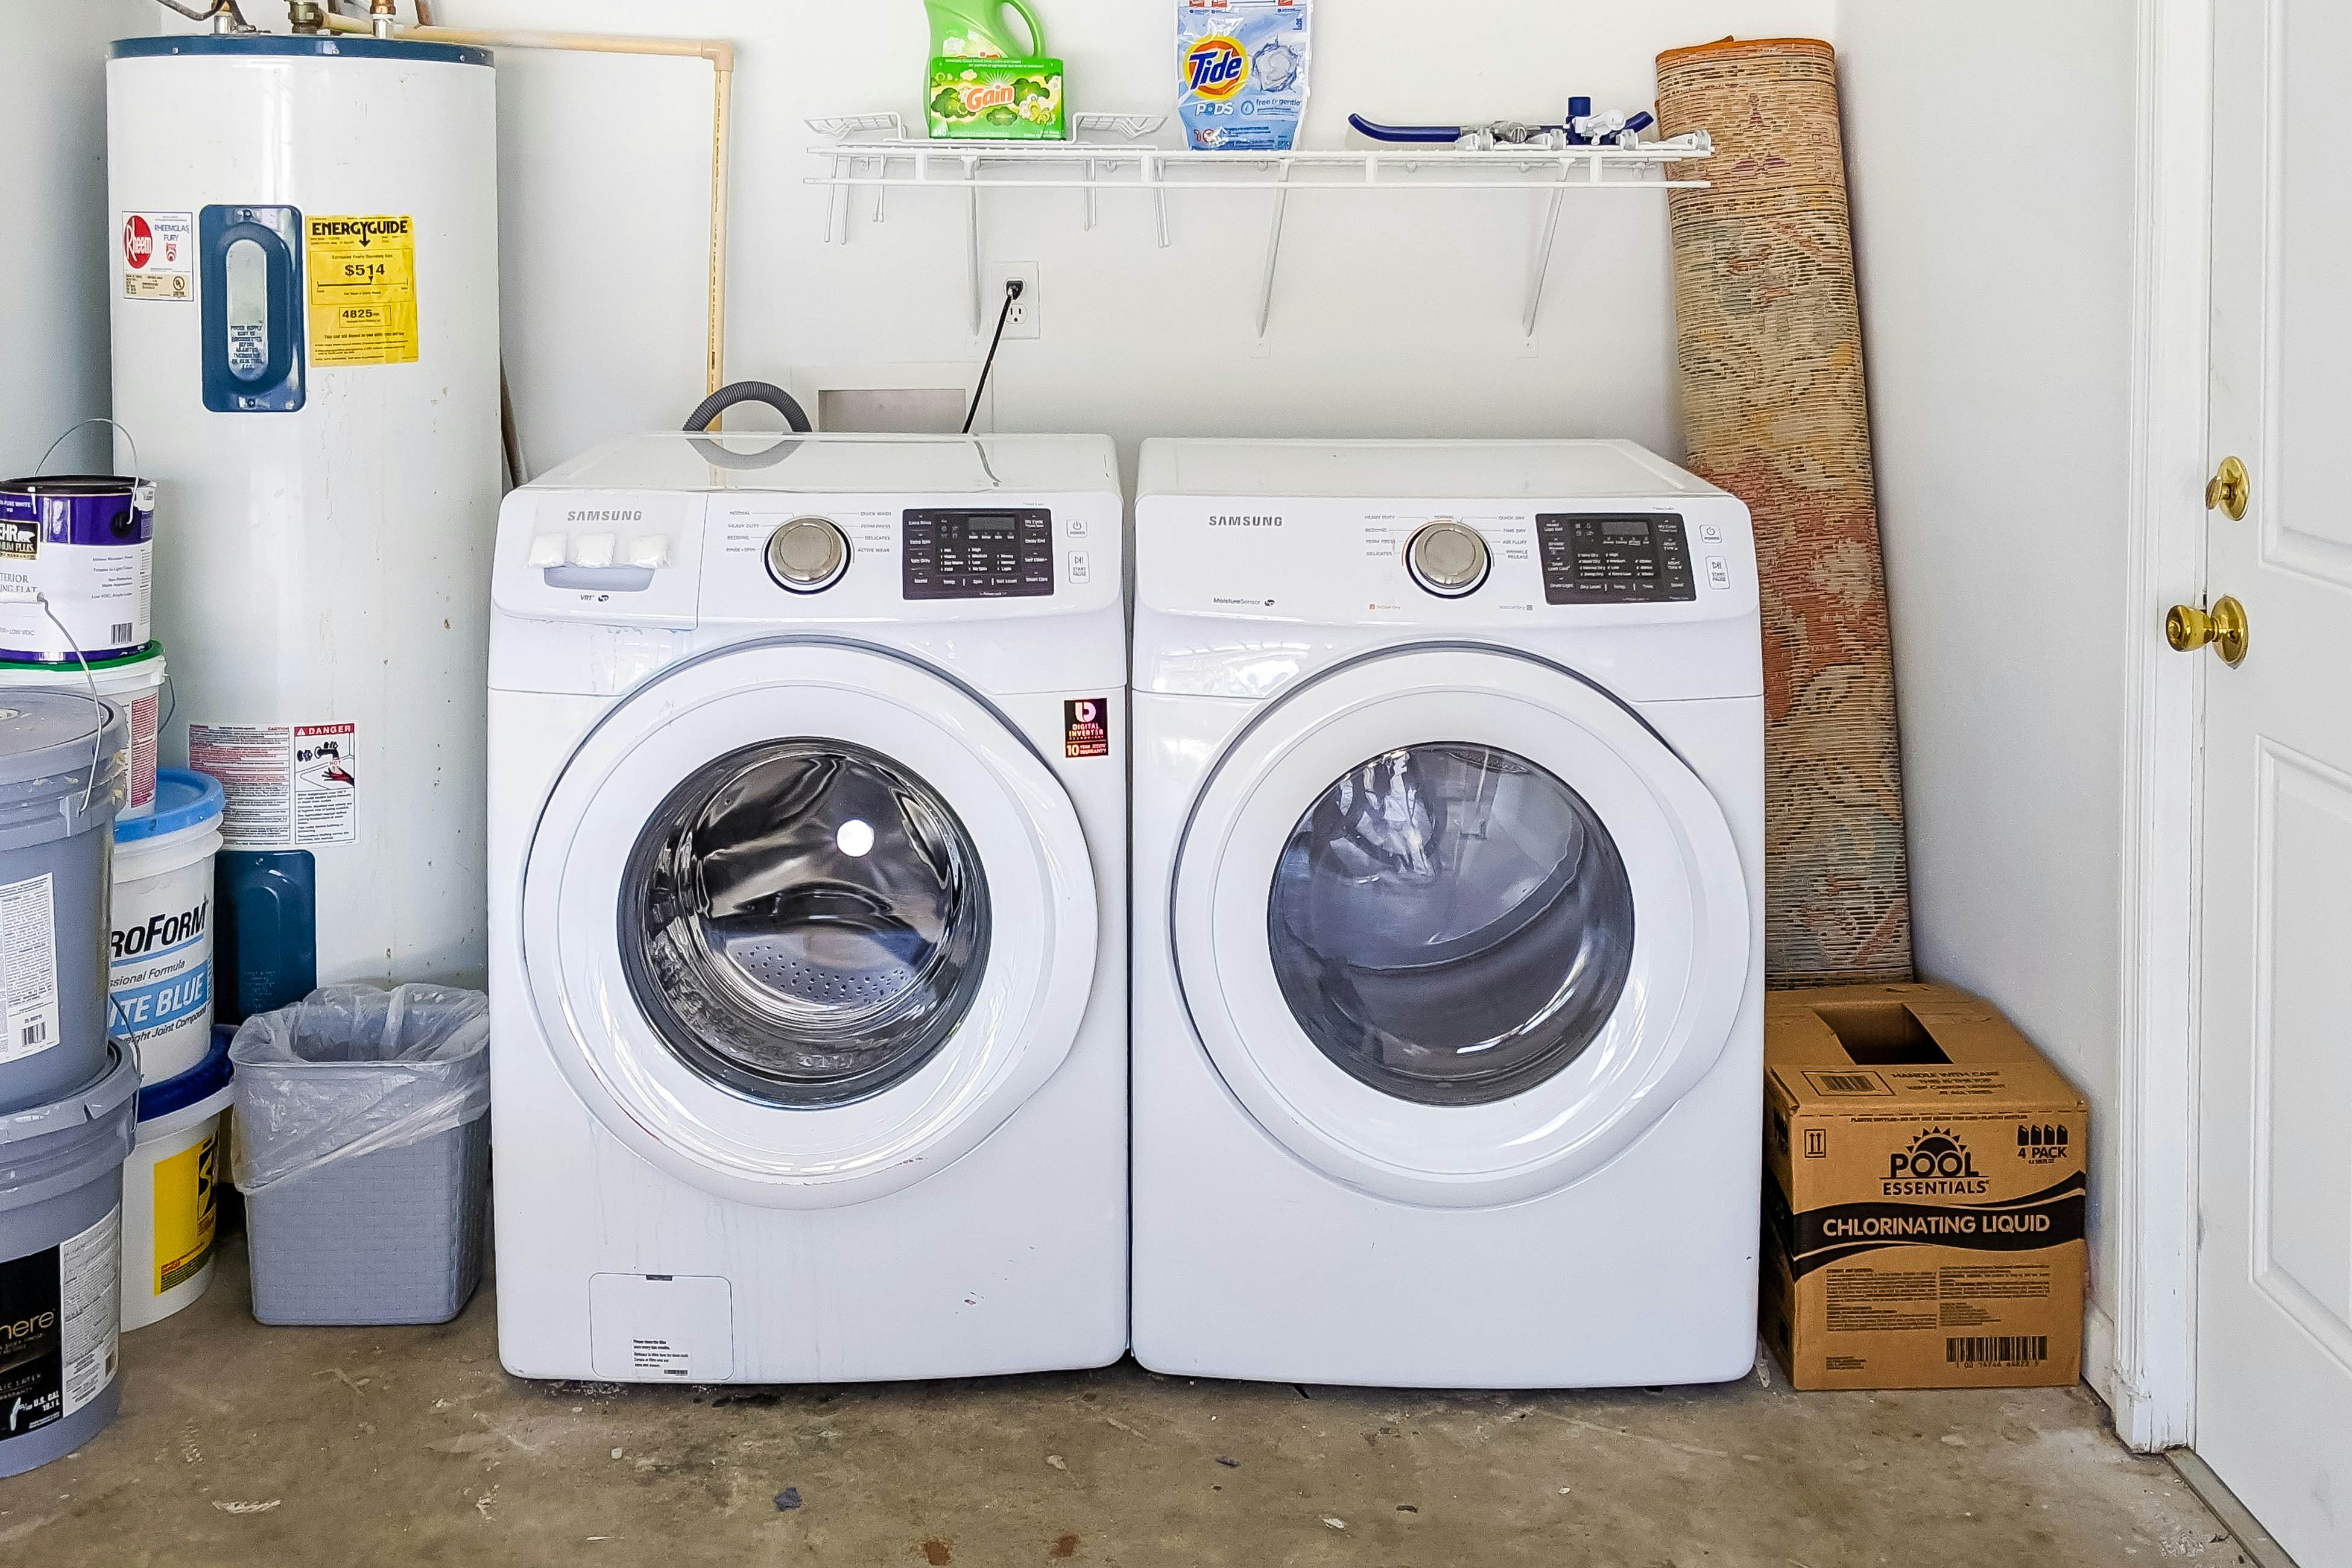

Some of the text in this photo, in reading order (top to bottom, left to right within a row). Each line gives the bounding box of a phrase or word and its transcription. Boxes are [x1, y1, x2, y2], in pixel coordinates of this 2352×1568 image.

[1189, 49, 1242, 90] Tide
[967, 85, 1013, 110] Gain
[1195, 103, 1234, 116] PODS
[312, 221, 408, 237] ENERGYGUIDE
[126, 218, 153, 261] Rheem
[344, 264, 385, 277] $514
[342, 309, 373, 318] 4825
[567, 511, 642, 522] SAMSUNG
[1209, 516, 1283, 526] SAMSUNG
[0, 523, 18, 542] EHR
[0, 573, 29, 583] TERIOR
[308, 726, 351, 735] DANGER
[1066, 744, 1080, 756] 10
[110, 959, 185, 987] ssional Formula
[109, 972, 205, 1028] ITE BLUE
[152, 1023, 174, 1038] Joint
[2017, 1146, 2068, 1159] 4 PACK
[1890, 1151, 1979, 1178] POOL
[1883, 1180, 1987, 1196] ESSENTIALS
[1822, 1215, 2050, 1237] CHLORINATING LIQUID
